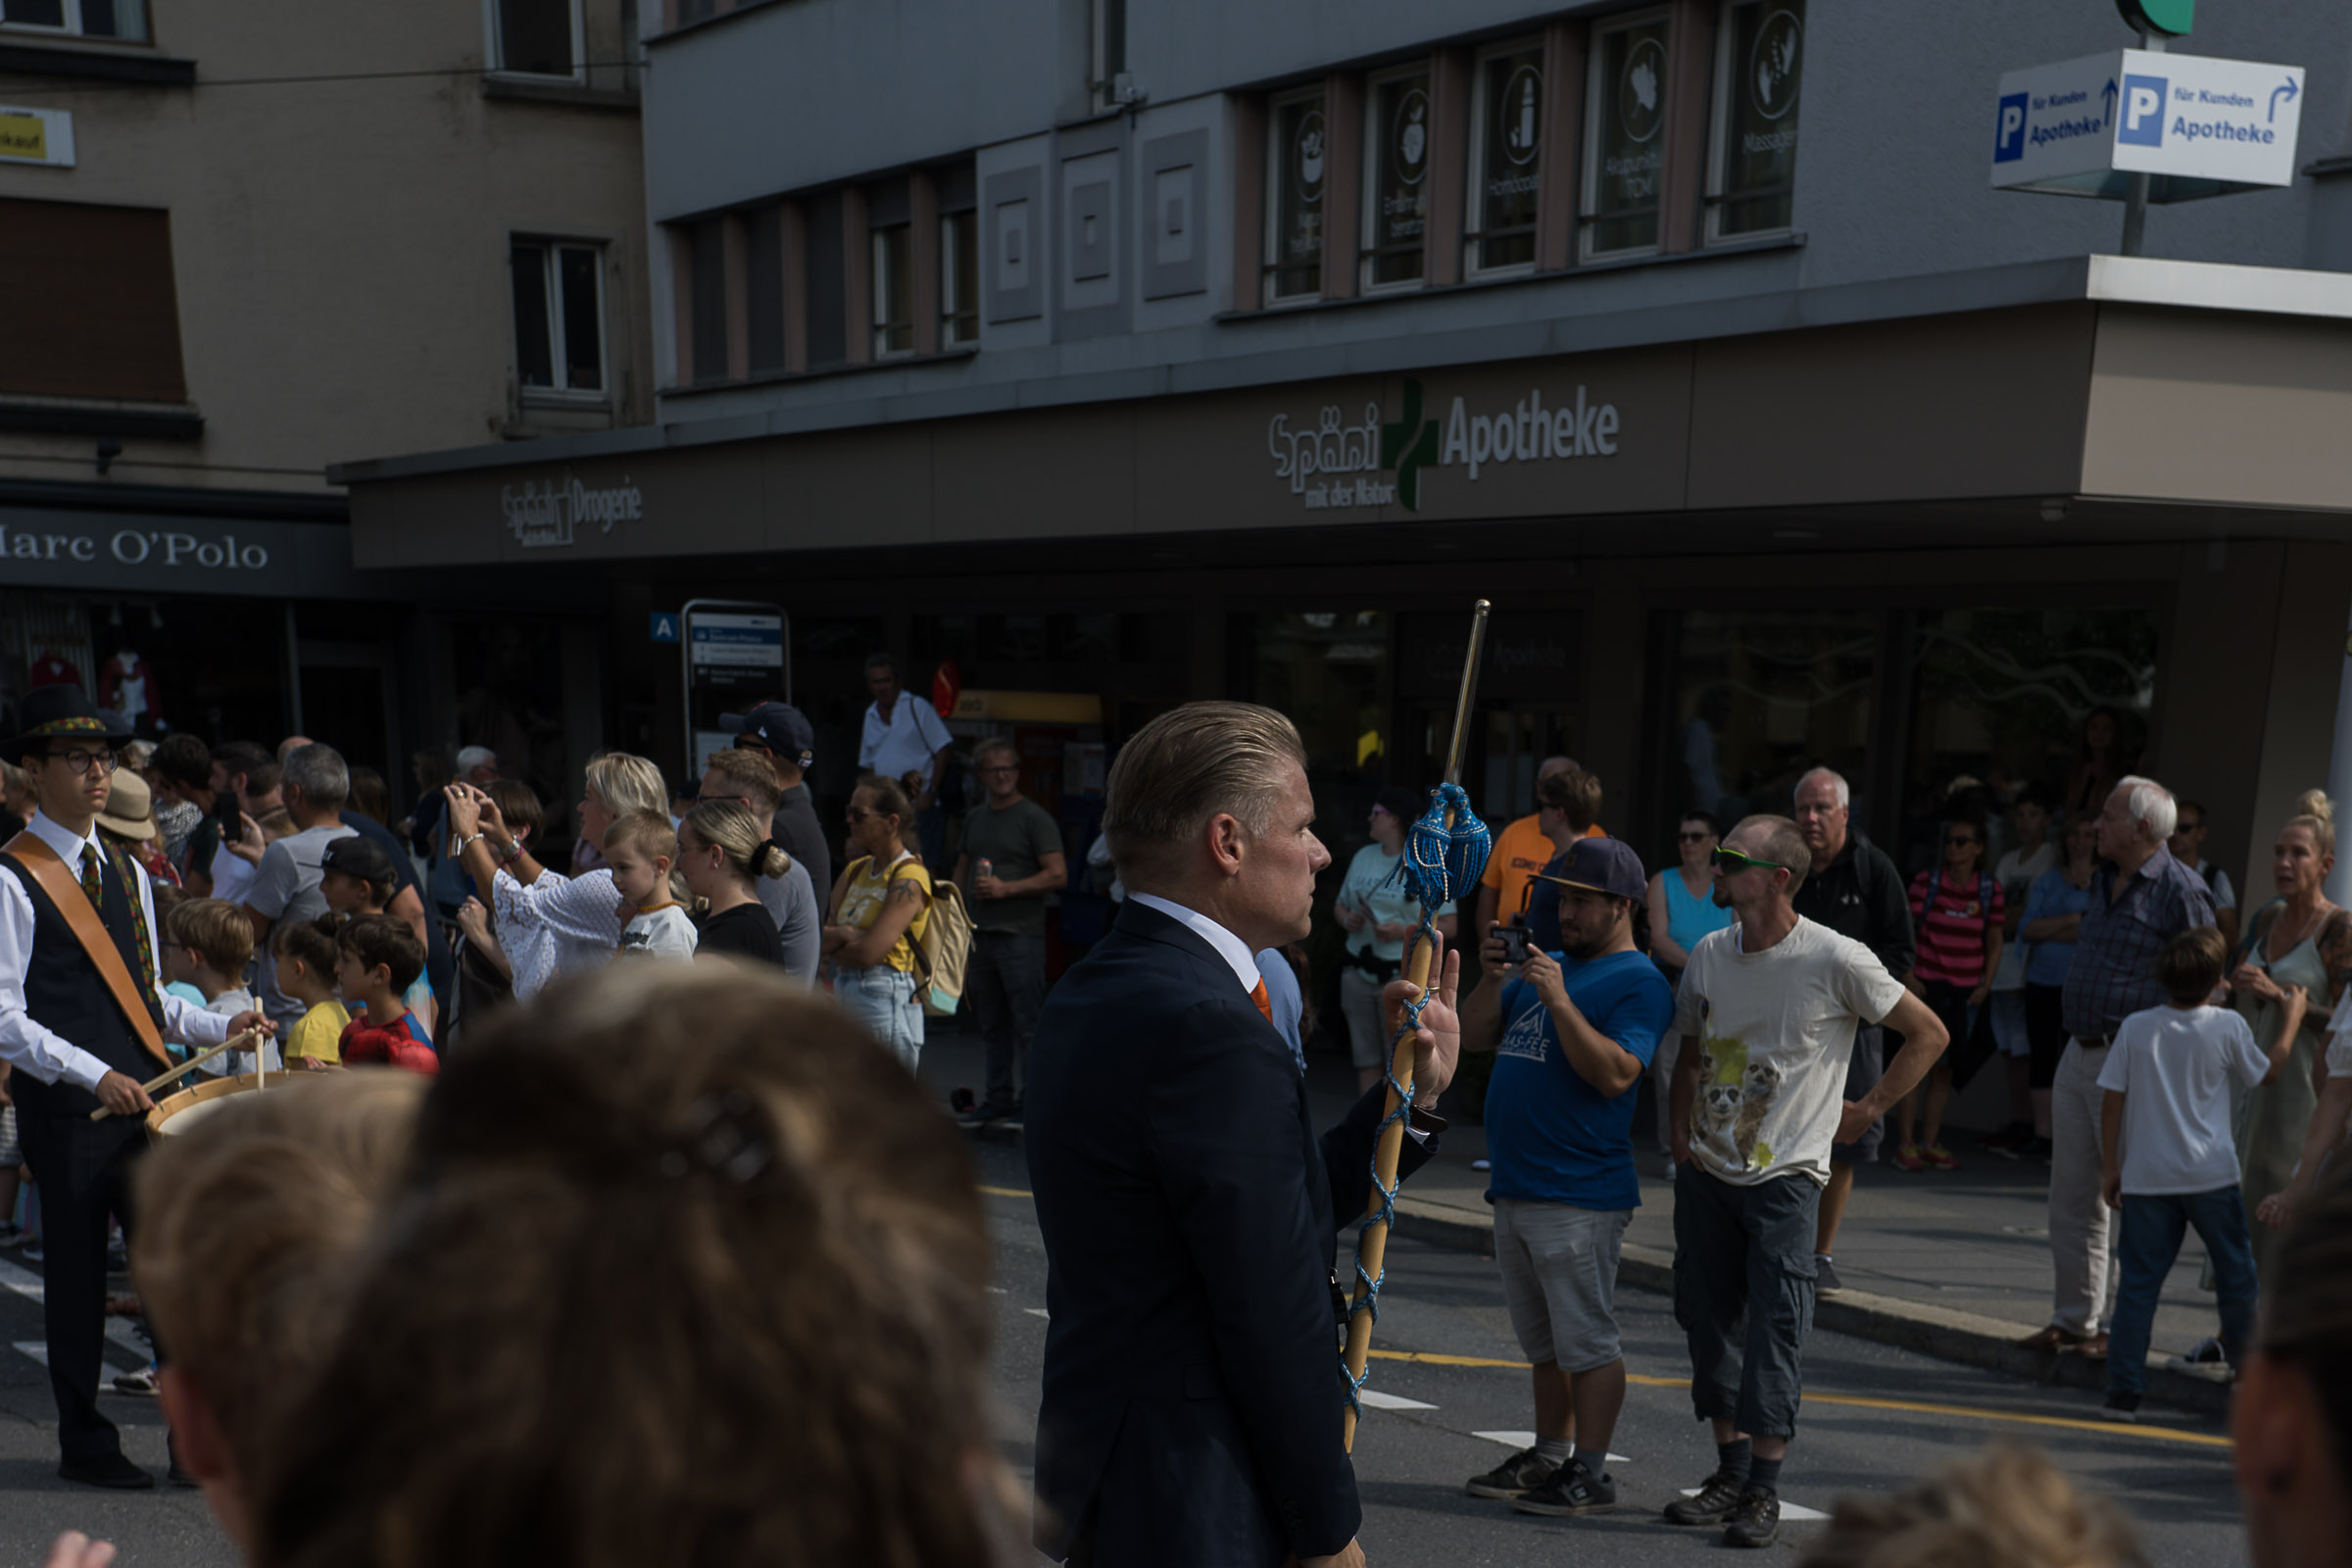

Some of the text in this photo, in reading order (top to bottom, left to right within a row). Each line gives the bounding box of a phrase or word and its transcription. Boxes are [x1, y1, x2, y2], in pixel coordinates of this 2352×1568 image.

[2032, 90, 2087, 110] für Kunden
[2127, 85, 2160, 131] P
[2174, 86, 2255, 108] für Kunden
[1999, 105, 2024, 150] P
[2030, 116, 2101, 148] Apotheke
[2172, 115, 2276, 145] Apotheke
[1443, 383, 1620, 481] Apotheke
[572, 473, 643, 535] Drogerie
[1305, 478, 1396, 509] mit der Natur
[111, 529, 269, 570] O'Polo
[656, 616, 673, 638] A
